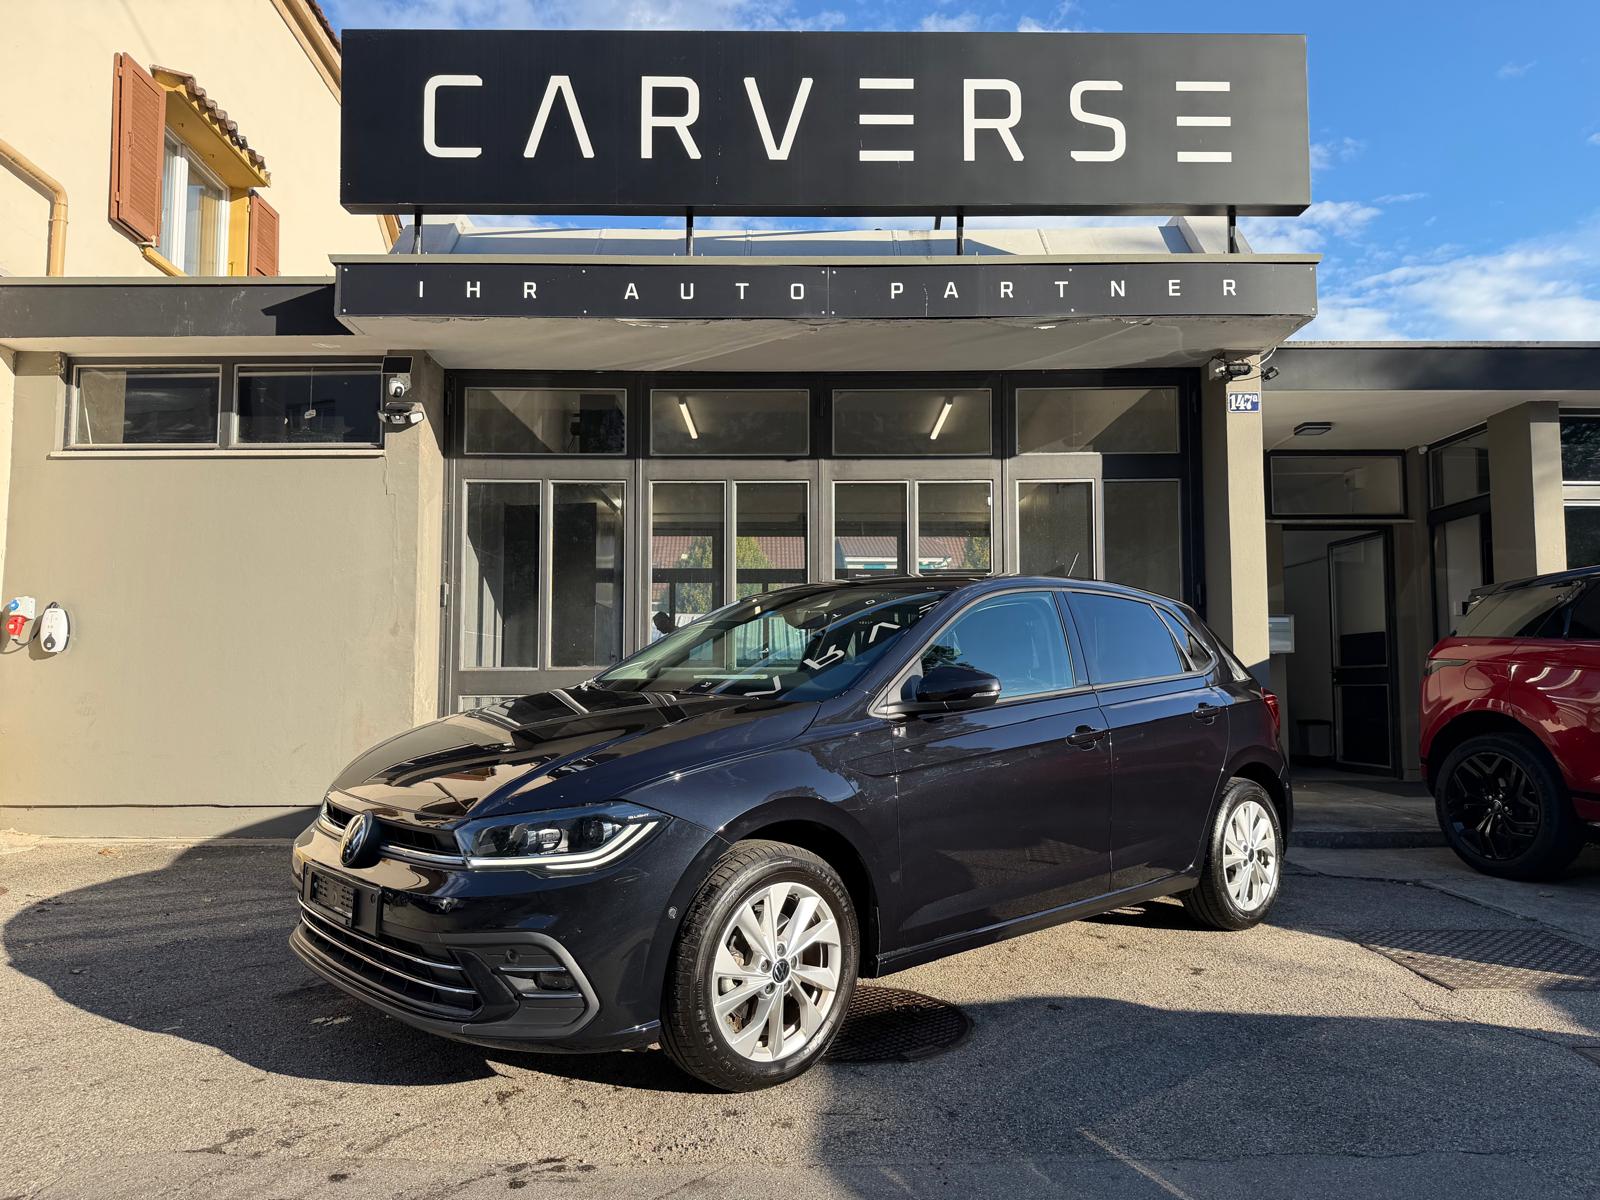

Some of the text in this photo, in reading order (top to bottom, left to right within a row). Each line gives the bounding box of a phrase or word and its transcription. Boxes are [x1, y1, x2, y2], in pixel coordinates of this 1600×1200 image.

[423, 74, 1233, 163] CARVERSE
[419, 278, 1238, 300] IHR AUTO PARTNER
